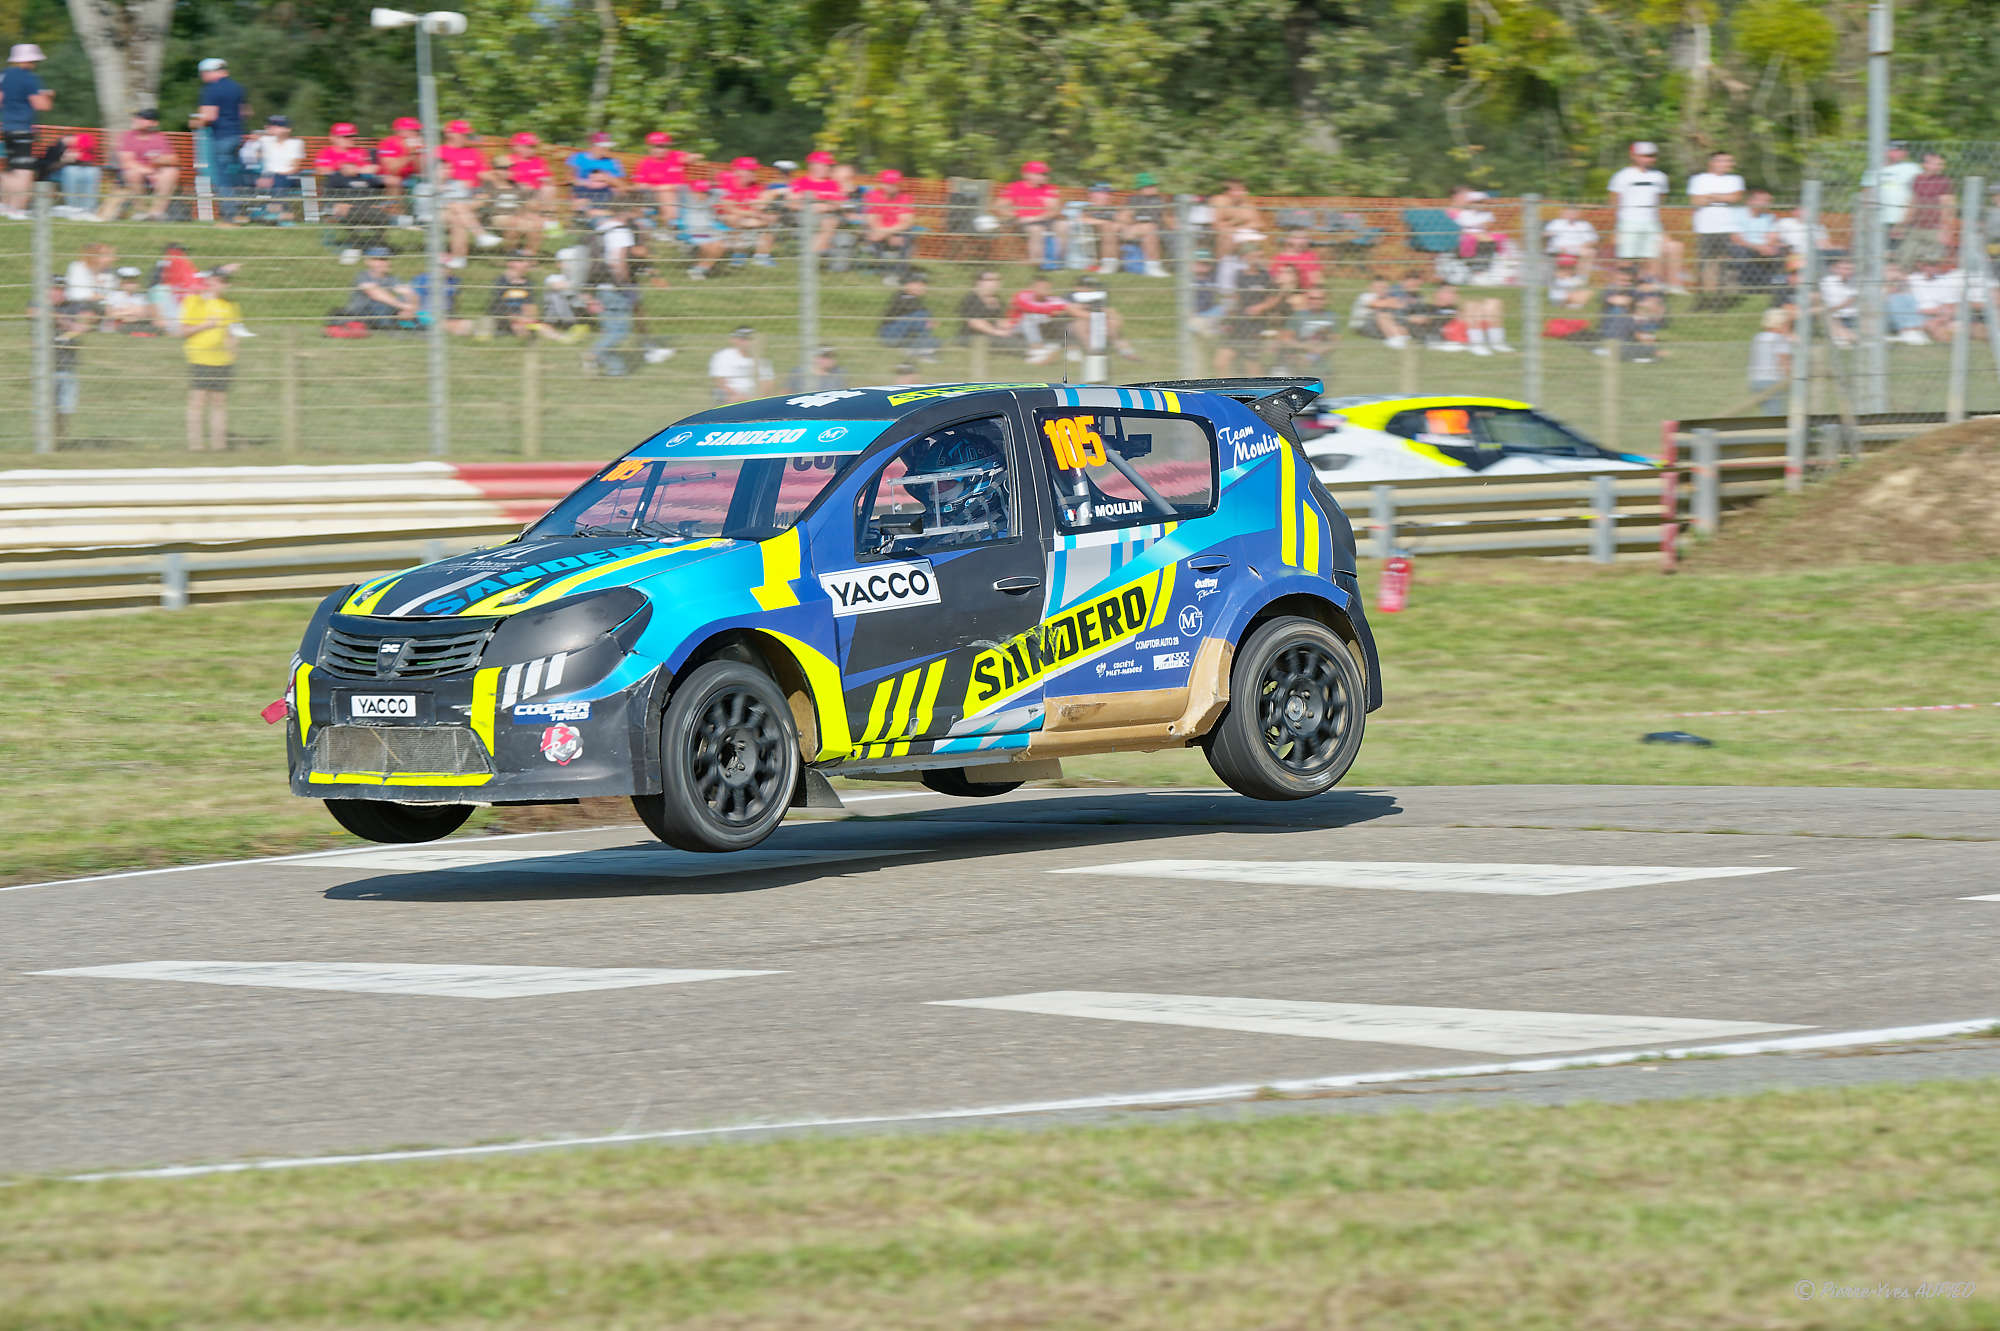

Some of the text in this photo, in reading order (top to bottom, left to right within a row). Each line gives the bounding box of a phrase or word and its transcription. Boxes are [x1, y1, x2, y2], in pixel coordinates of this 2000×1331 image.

[696, 428, 808, 446] SANDERO
[1043, 415, 1107, 470] 105
[1218, 425, 1254, 446] Team
[1233, 433, 1282, 471] Moulin
[1095, 500, 1143, 517] MOULIN
[831, 569, 930, 607] YACCO
[974, 586, 1147, 701] SANDERO
[358, 698, 408, 714] YACCO
[514, 701, 591, 715] COOPER
